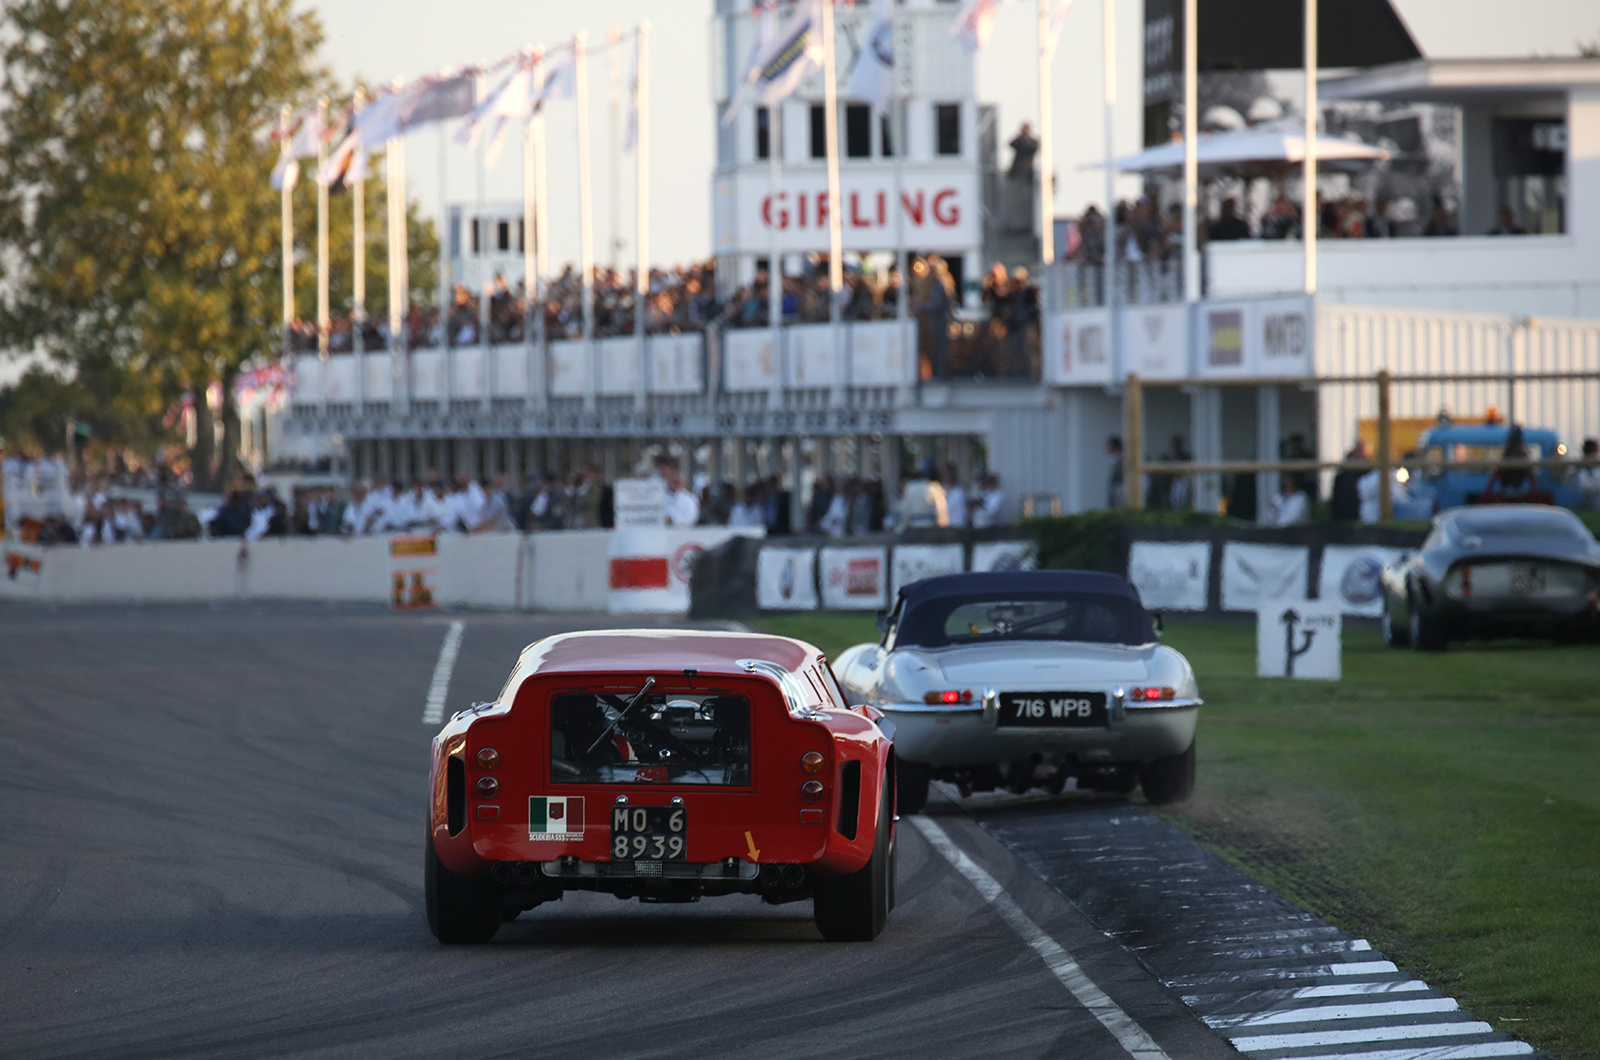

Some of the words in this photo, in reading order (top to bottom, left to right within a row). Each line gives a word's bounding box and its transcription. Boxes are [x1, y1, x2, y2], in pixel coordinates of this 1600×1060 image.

[760, 188, 961, 229] GIRLING
[1011, 699, 1046, 718] 716
[1049, 698, 1092, 718] WPB
[614, 808, 647, 833] MO
[669, 809, 684, 833] 6
[614, 835, 684, 859] 8939
